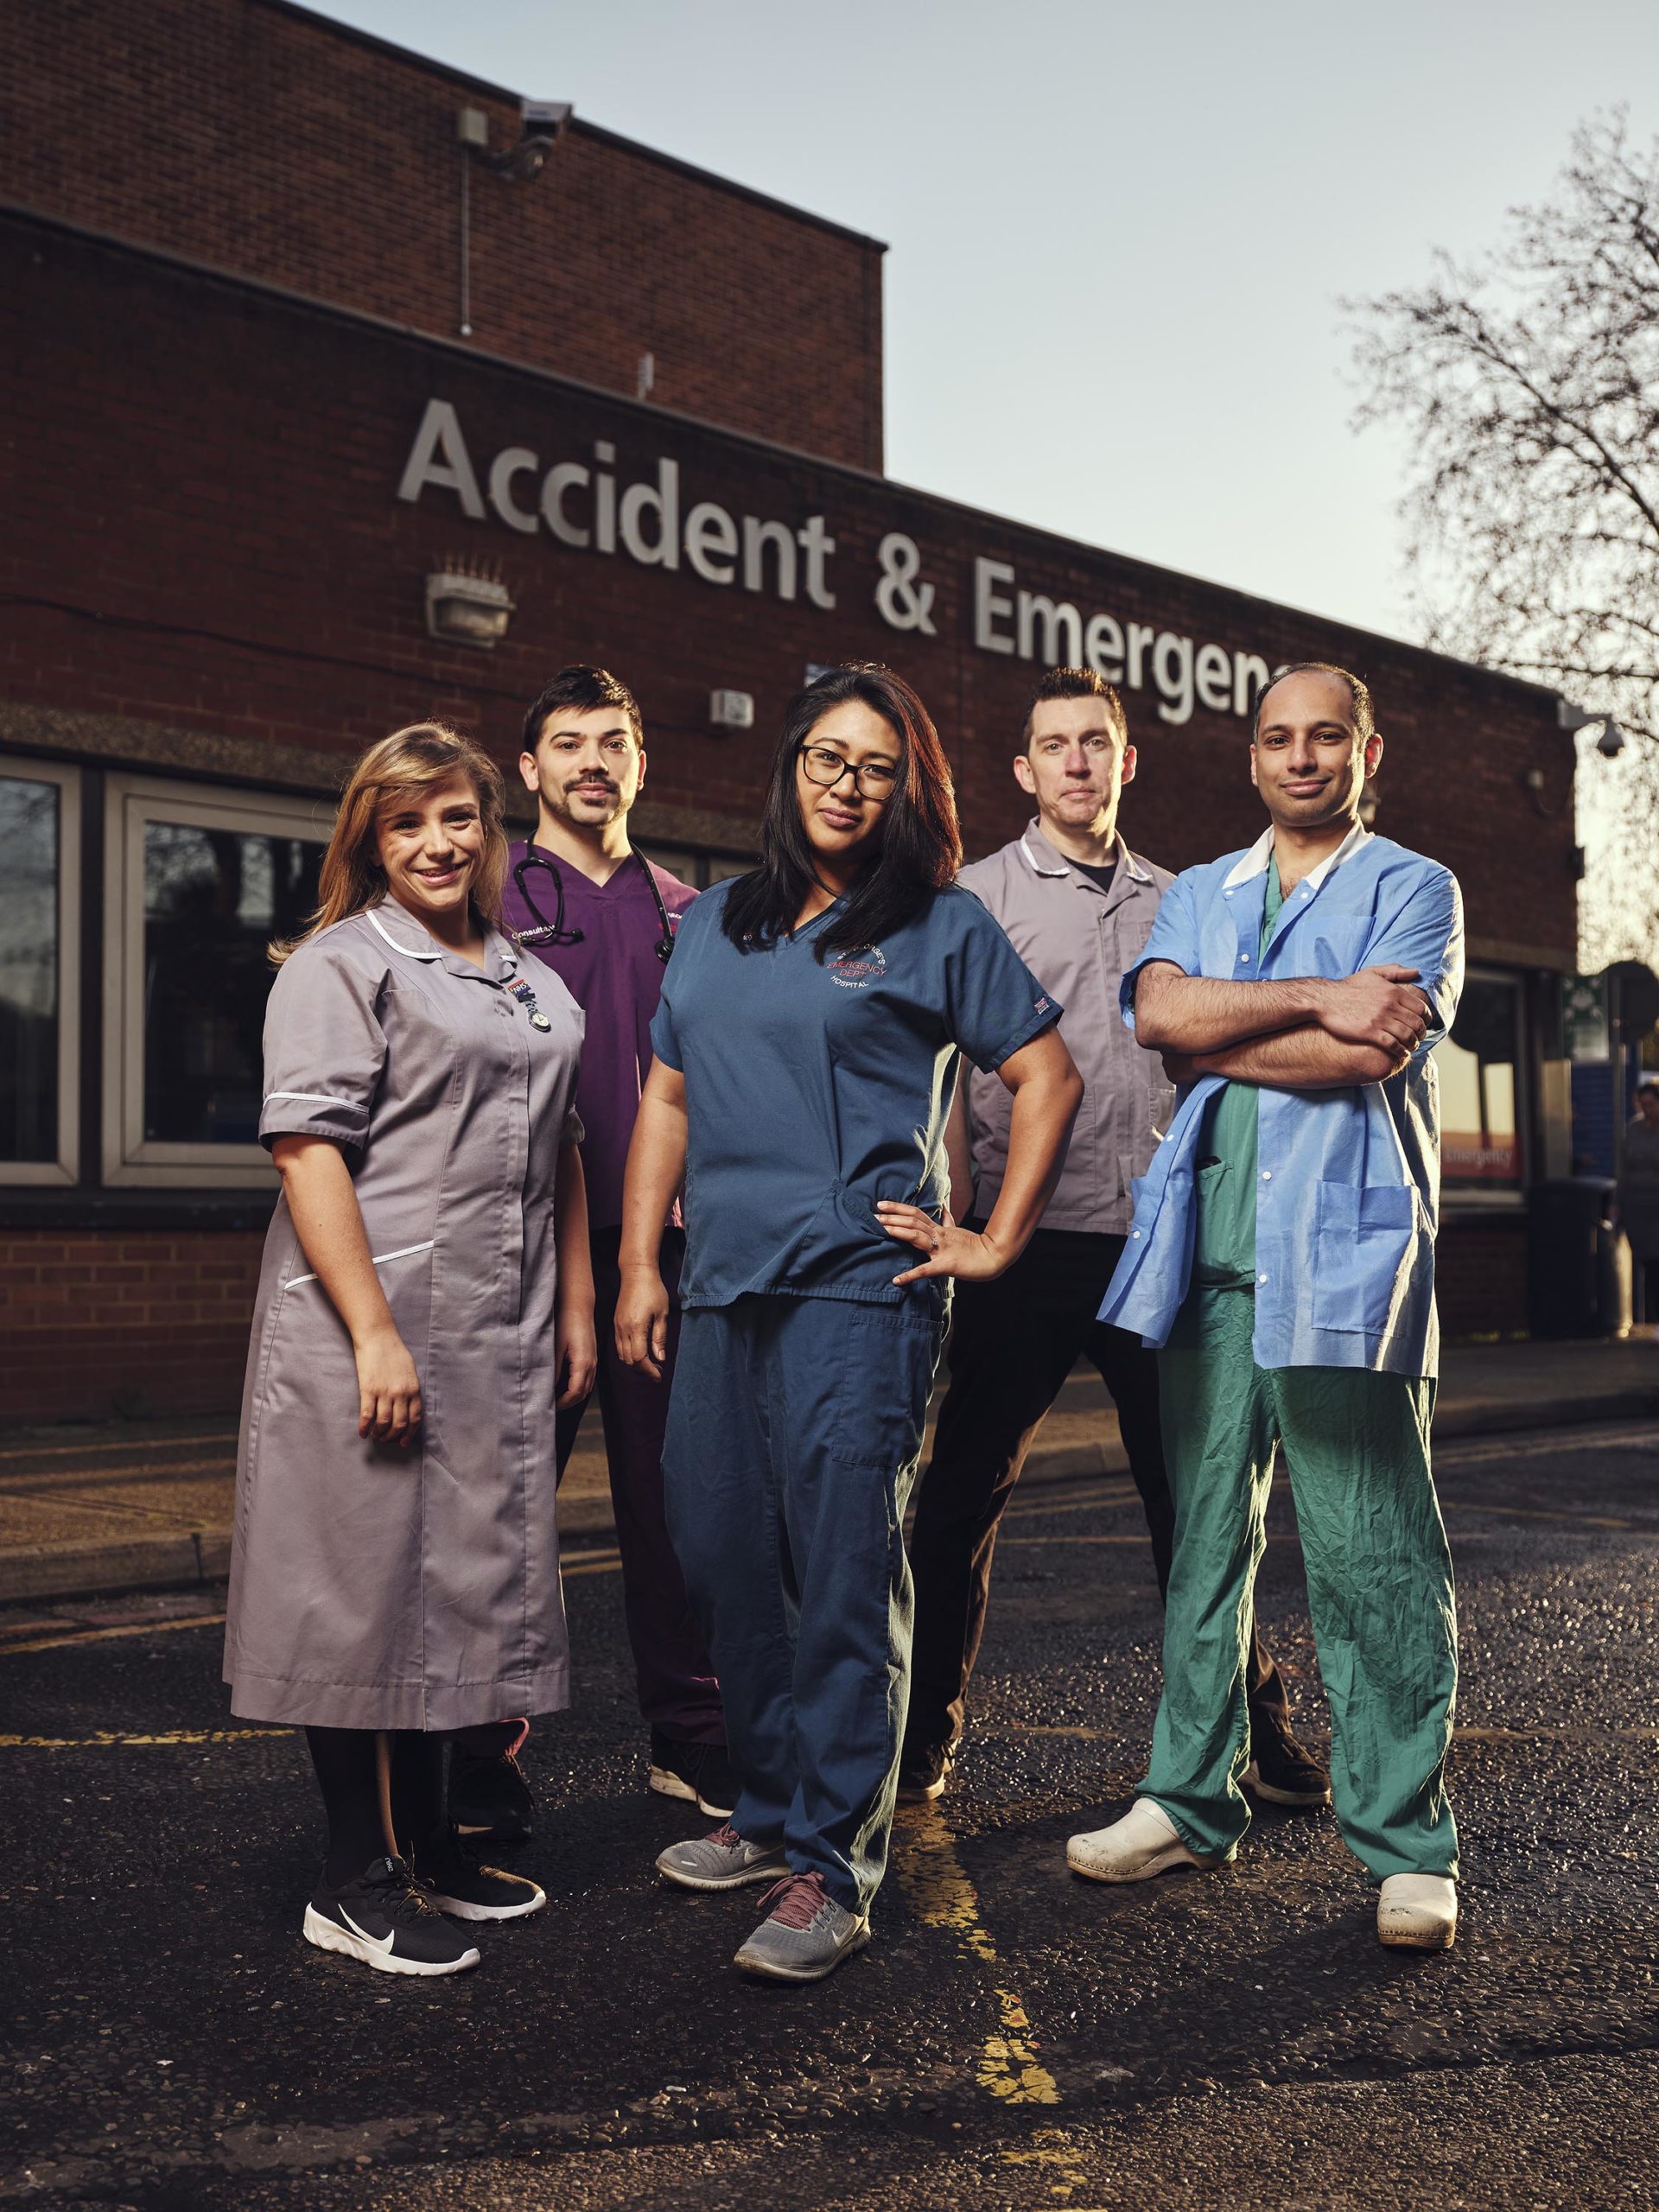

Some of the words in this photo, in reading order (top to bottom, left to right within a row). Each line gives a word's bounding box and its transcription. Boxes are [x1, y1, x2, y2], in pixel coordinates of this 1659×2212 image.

[397, 397, 836, 610] Accident
[875, 531, 938, 636] &
[974, 556, 1295, 726] Emergen
[827, 961, 887, 976] EMERGENCY
[839, 968, 867, 978] DEPT
[512, 982, 527, 994] NHS
[830, 975, 869, 988] HOSPITAL
